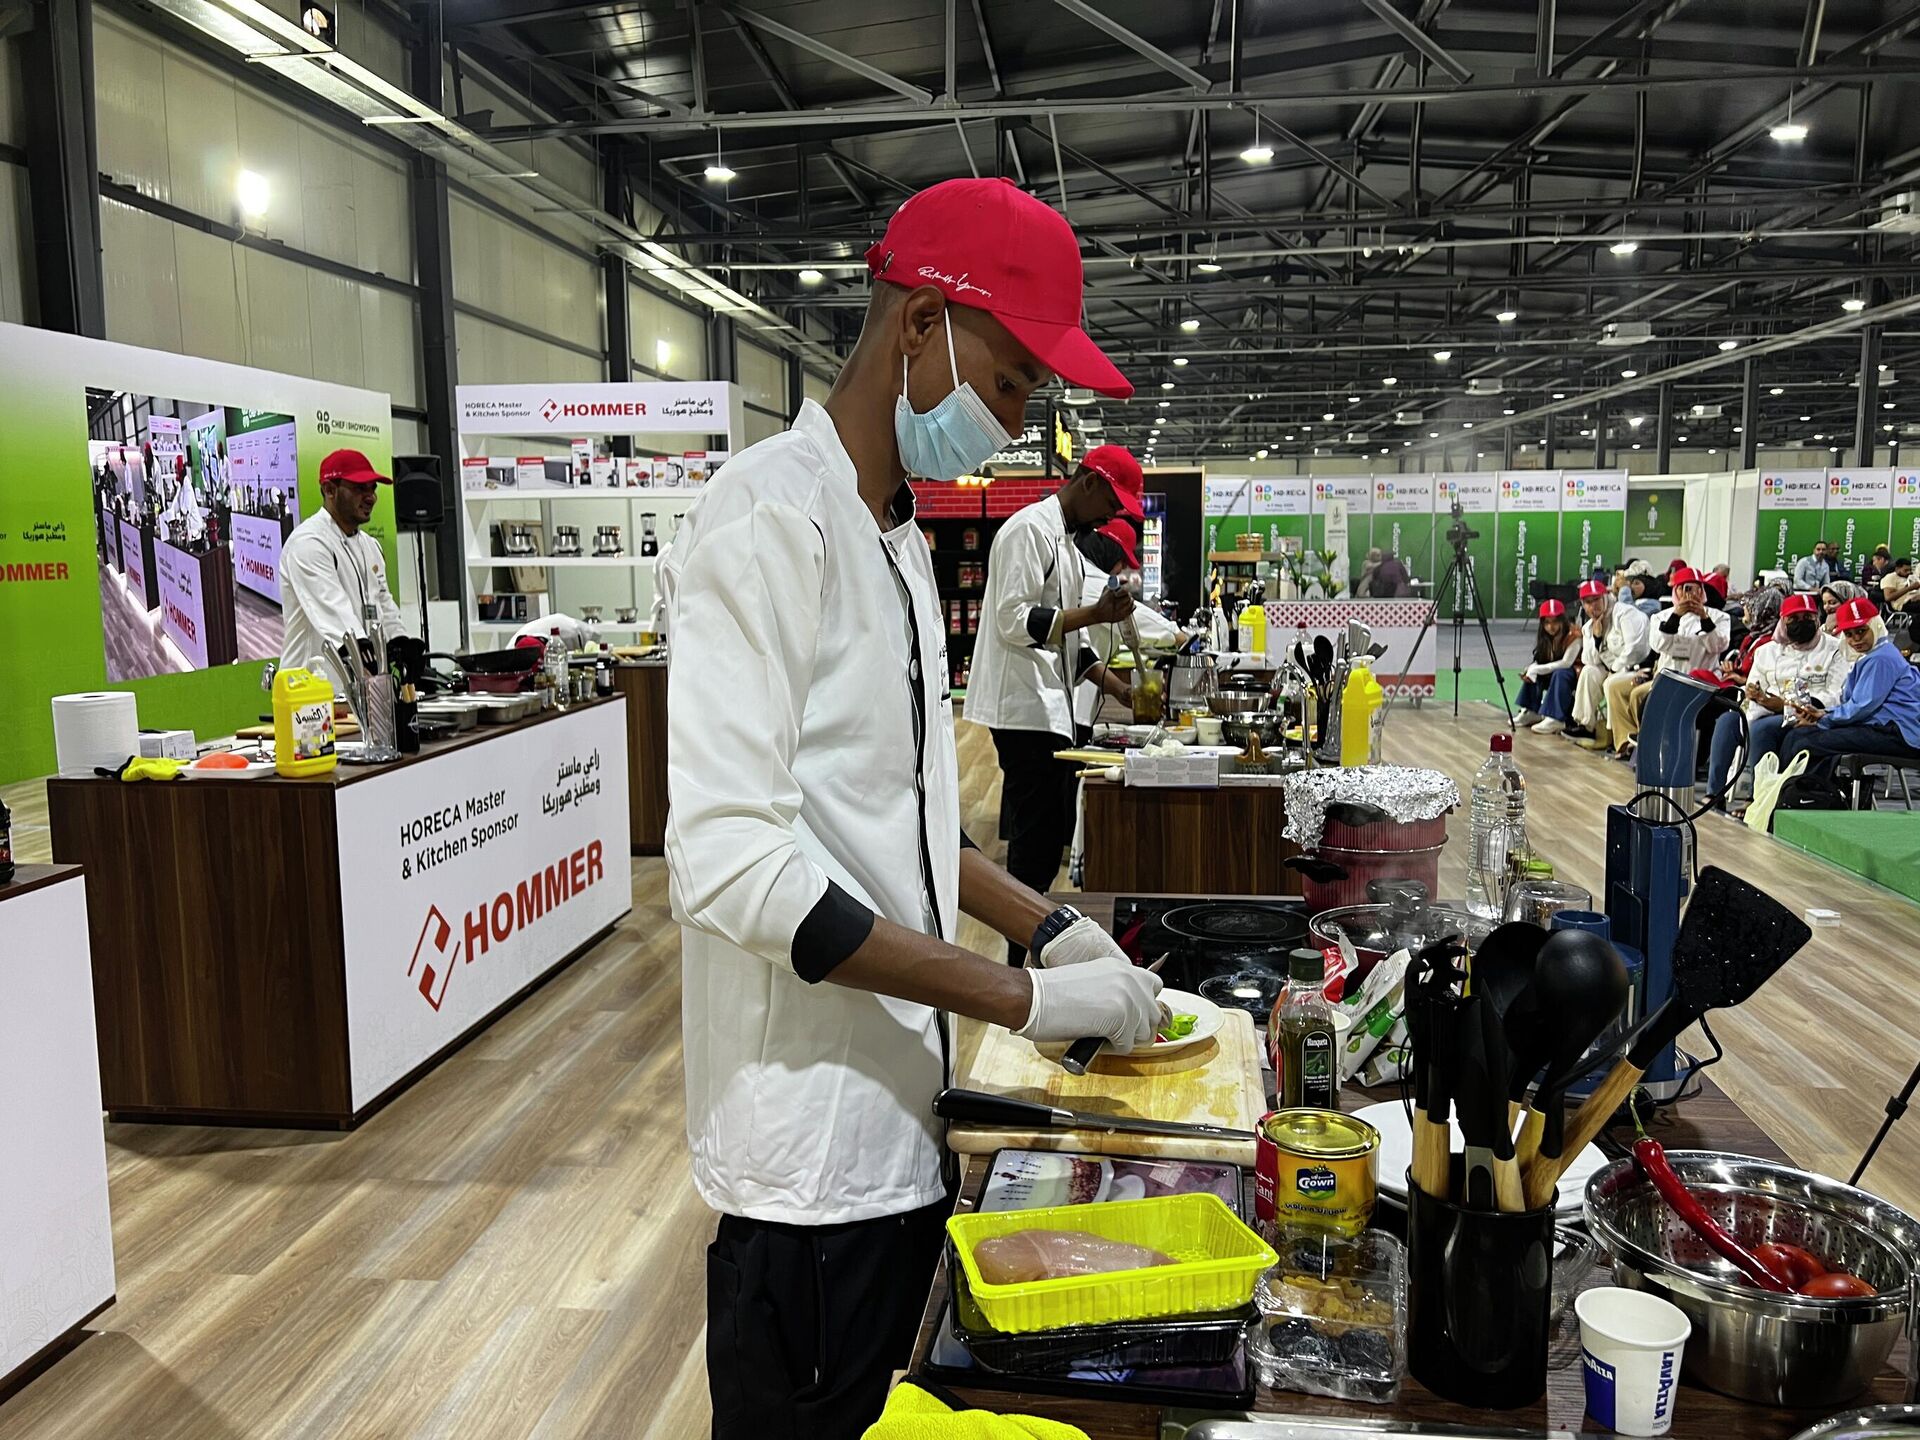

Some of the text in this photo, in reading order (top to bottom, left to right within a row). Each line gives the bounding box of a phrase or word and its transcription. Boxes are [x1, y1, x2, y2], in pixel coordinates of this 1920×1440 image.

[501, 410, 531, 419] Sponsor
[562, 402, 647, 417] HOMMER
[1580, 519, 1591, 556] Lounge
[1776, 518, 1788, 556] Lounge
[1843, 518, 1855, 556] Lounge
[1514, 520, 1526, 611] Hospitality Lounge
[556, 748, 600, 787] راعي ماستر
[542, 778, 601, 818] ومطبخ هوريكا
[400, 788, 506, 848] HORECA Master
[401, 812, 520, 880] & Kitchen Sponsor
[464, 838, 604, 965] HOMMER
[1298, 1177, 1335, 1190] Crown
[1653, 1352, 1674, 1420] LAVAZZA
